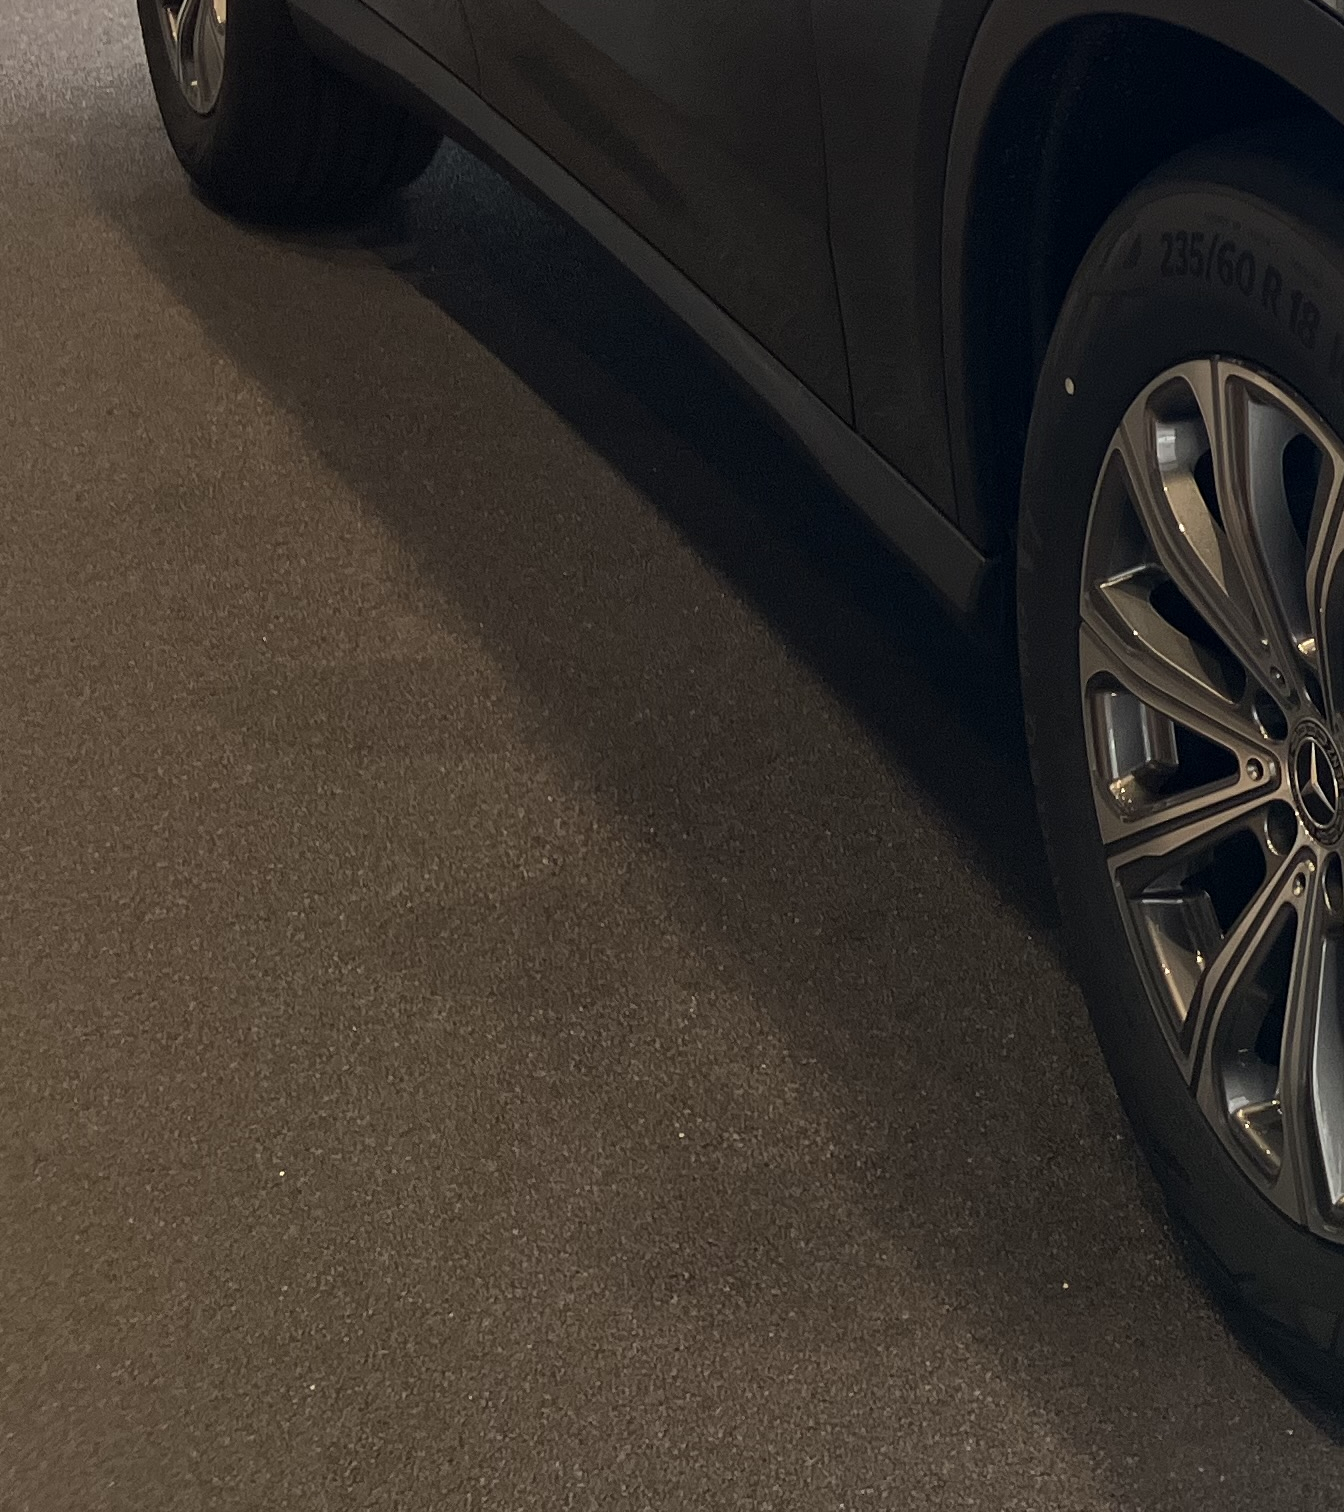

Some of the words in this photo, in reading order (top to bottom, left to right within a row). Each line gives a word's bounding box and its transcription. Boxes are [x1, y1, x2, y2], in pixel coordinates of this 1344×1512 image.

[1160, 229, 1256, 298] 235/60
[1261, 264, 1283, 318] R
[1288, 289, 1321, 351] 18
